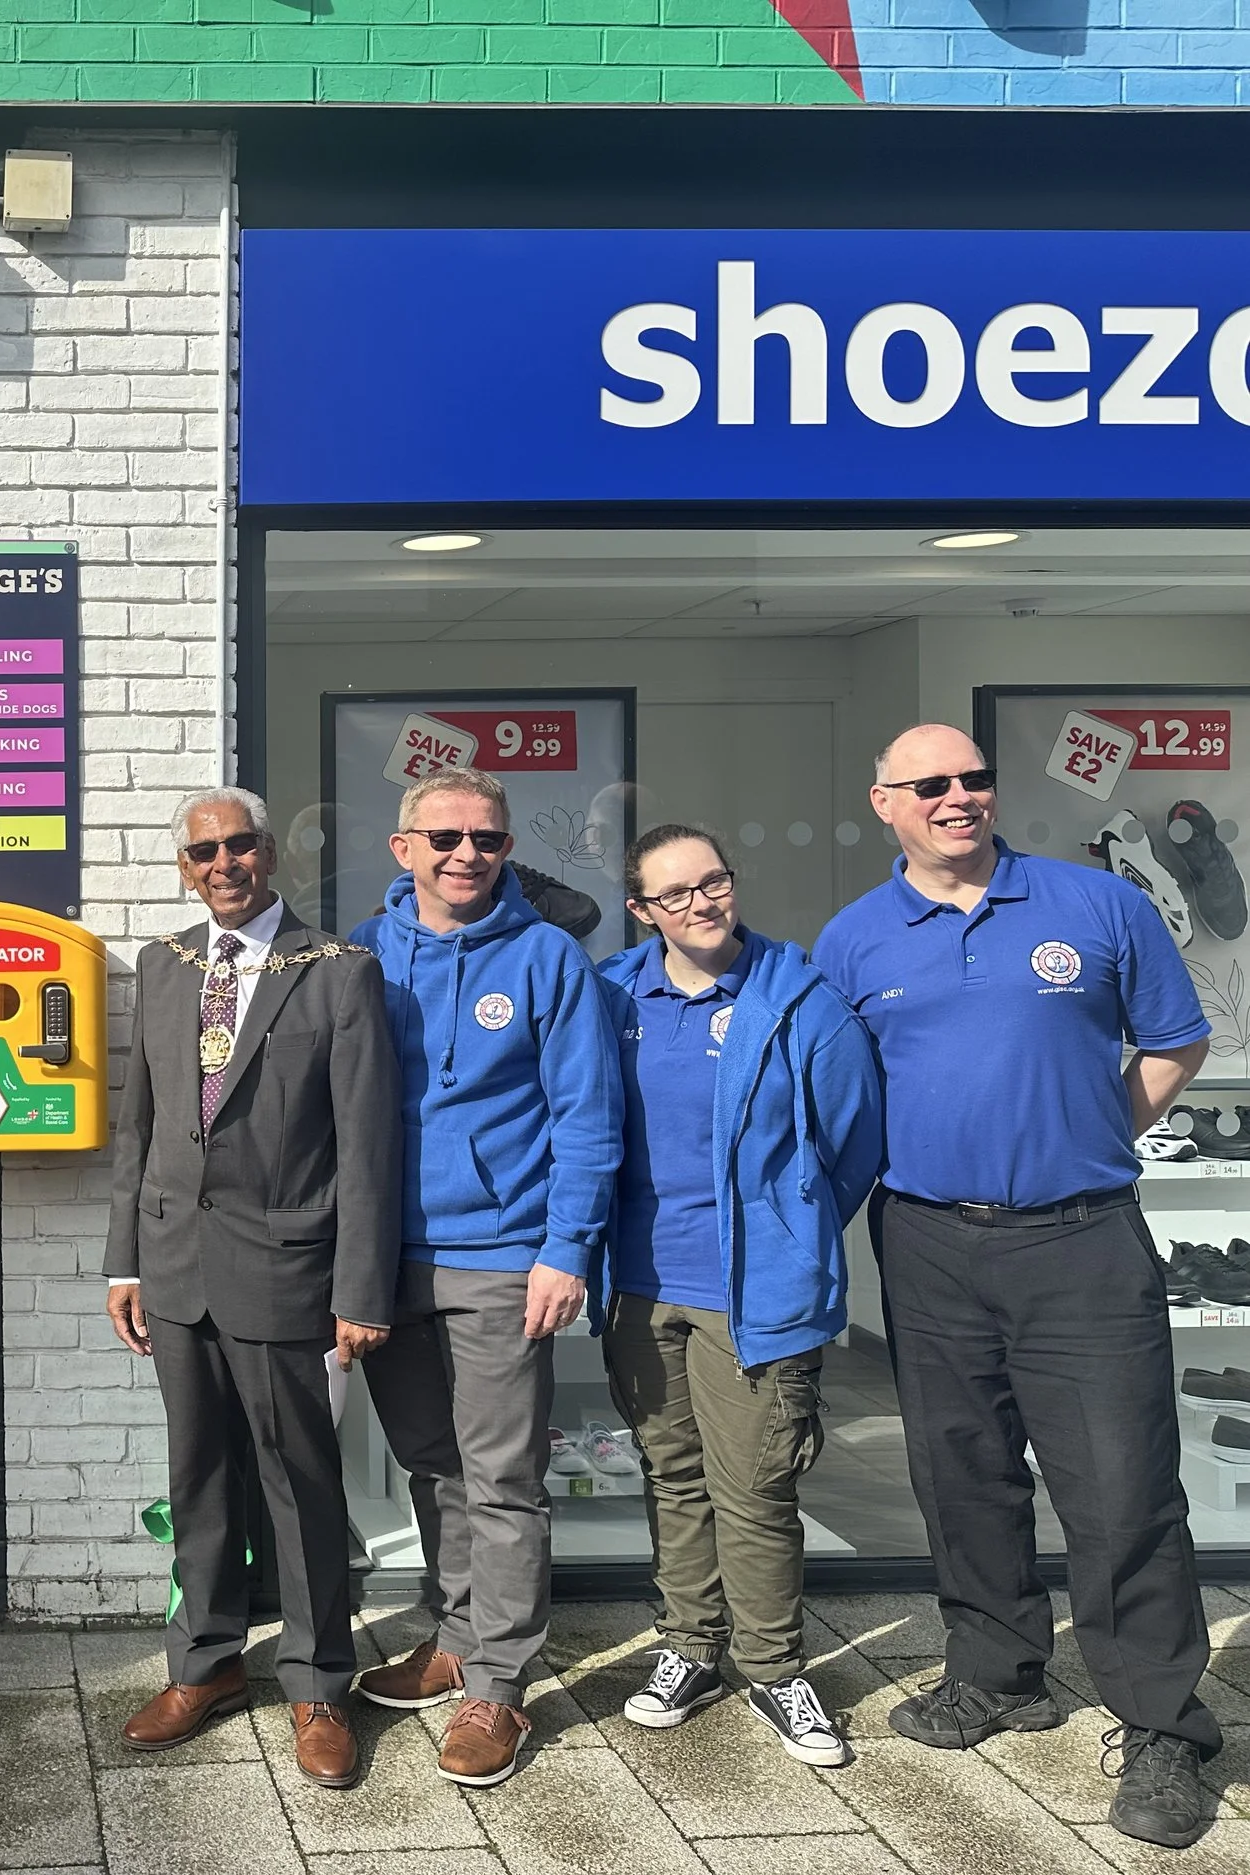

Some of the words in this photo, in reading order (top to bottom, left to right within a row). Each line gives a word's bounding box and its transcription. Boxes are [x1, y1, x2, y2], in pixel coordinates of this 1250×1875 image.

[23, 703, 57, 714] DOGS
[495, 720, 562, 758] 9.99
[531, 723, 561, 733] 12.99
[1066, 726, 1122, 764] SAVE
[1139, 719, 1225, 757] 12.99
[405, 729, 462, 766] SAVE
[1064, 751, 1103, 784] £2
[881, 987, 904, 1001] ANDY
